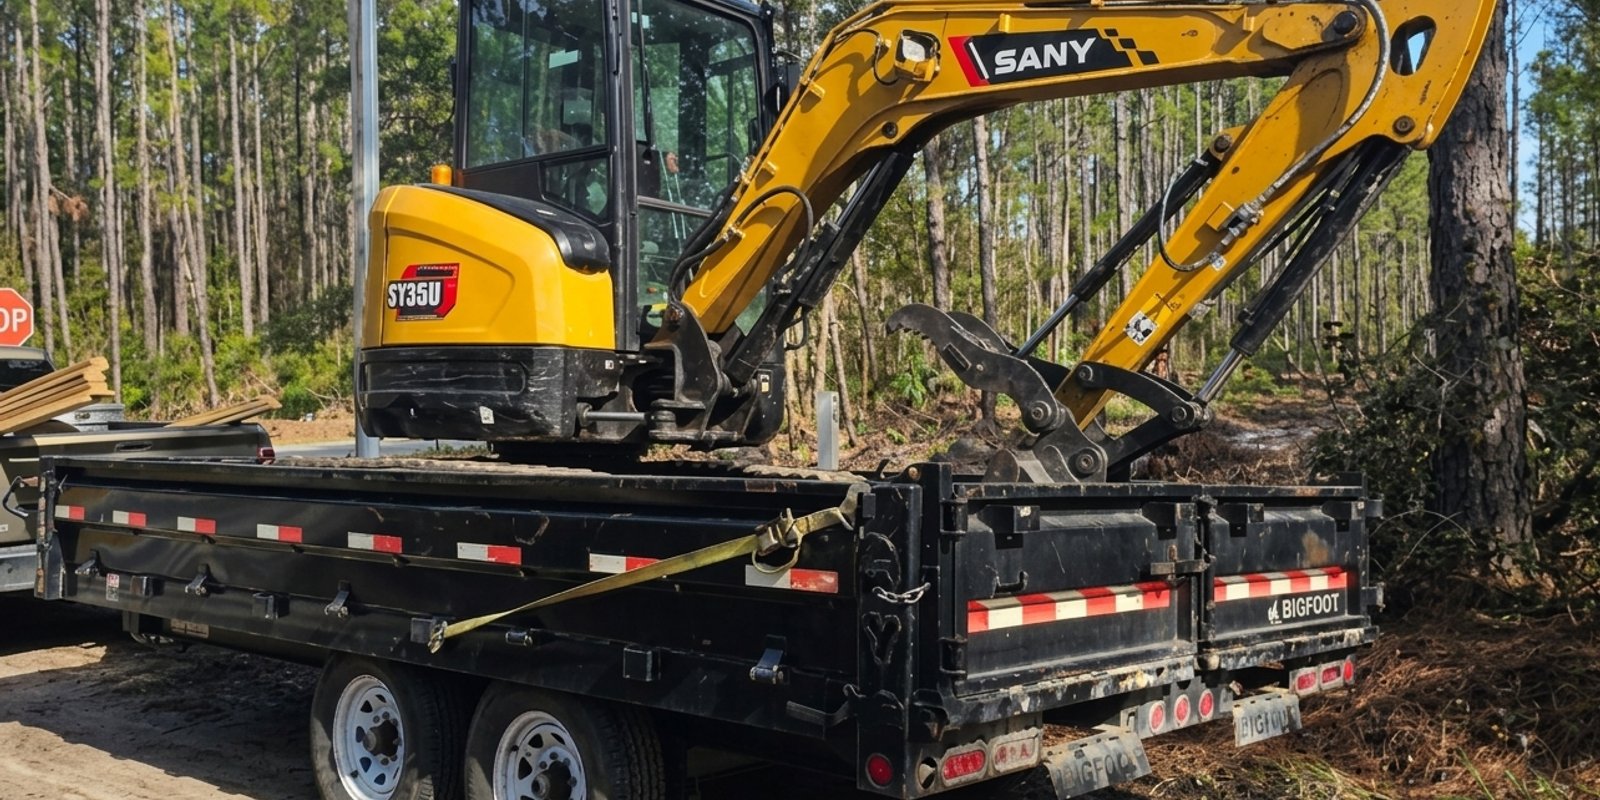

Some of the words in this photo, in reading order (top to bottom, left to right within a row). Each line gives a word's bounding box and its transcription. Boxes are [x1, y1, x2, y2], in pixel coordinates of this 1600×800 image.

[994, 37, 1096, 76] SANY
[387, 281, 441, 308] SY35U
[1282, 593, 1340, 619] BIGFOOT
